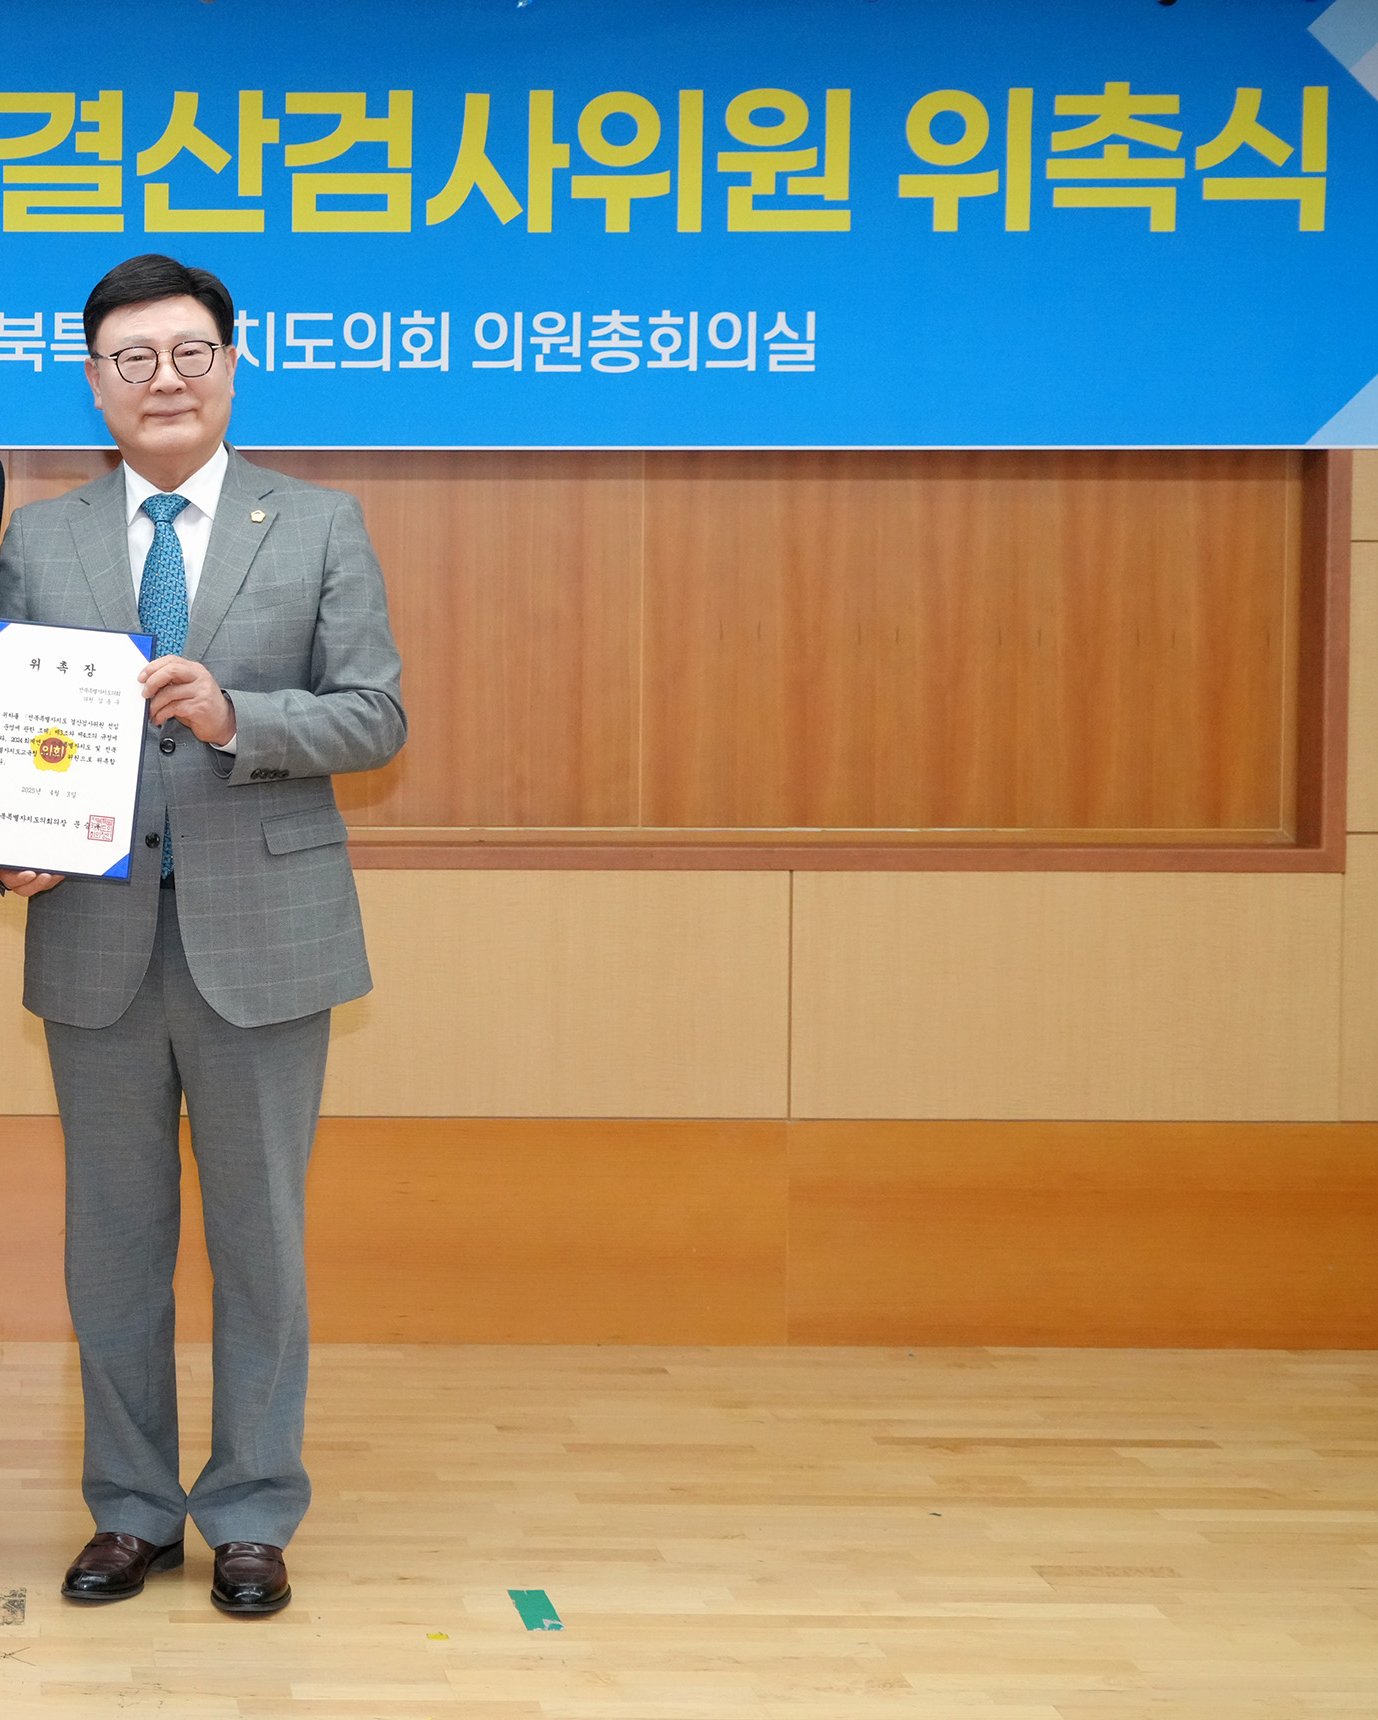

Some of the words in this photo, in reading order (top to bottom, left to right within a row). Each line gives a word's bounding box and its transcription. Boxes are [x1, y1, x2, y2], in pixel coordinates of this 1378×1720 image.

[899, 82, 1330, 233] 위촉식
[471, 309, 817, 373] 의원총회의실
[40, 744, 65, 757] 의회
